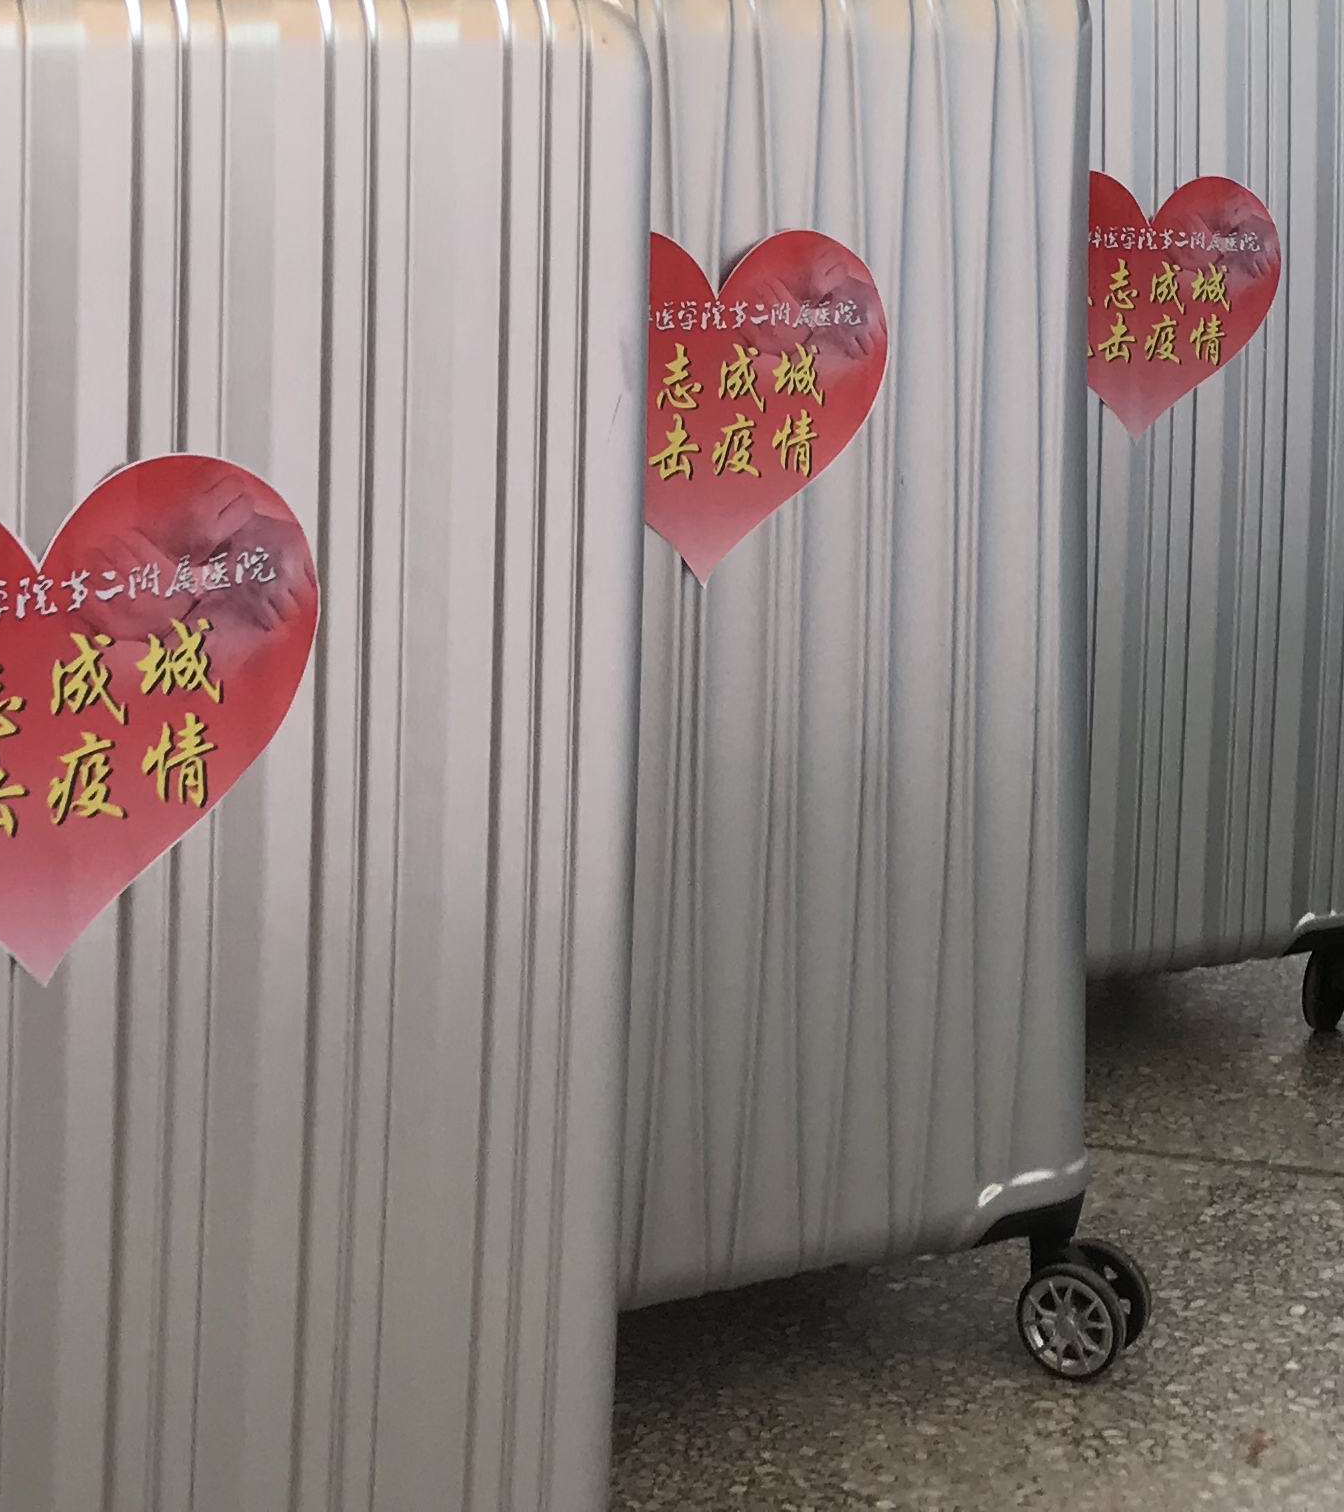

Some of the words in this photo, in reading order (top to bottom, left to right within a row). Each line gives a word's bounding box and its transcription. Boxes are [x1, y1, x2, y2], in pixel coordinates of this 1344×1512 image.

[1088, 258, 1231, 314] 志成城
[1088, 312, 1226, 366] 击疫情
